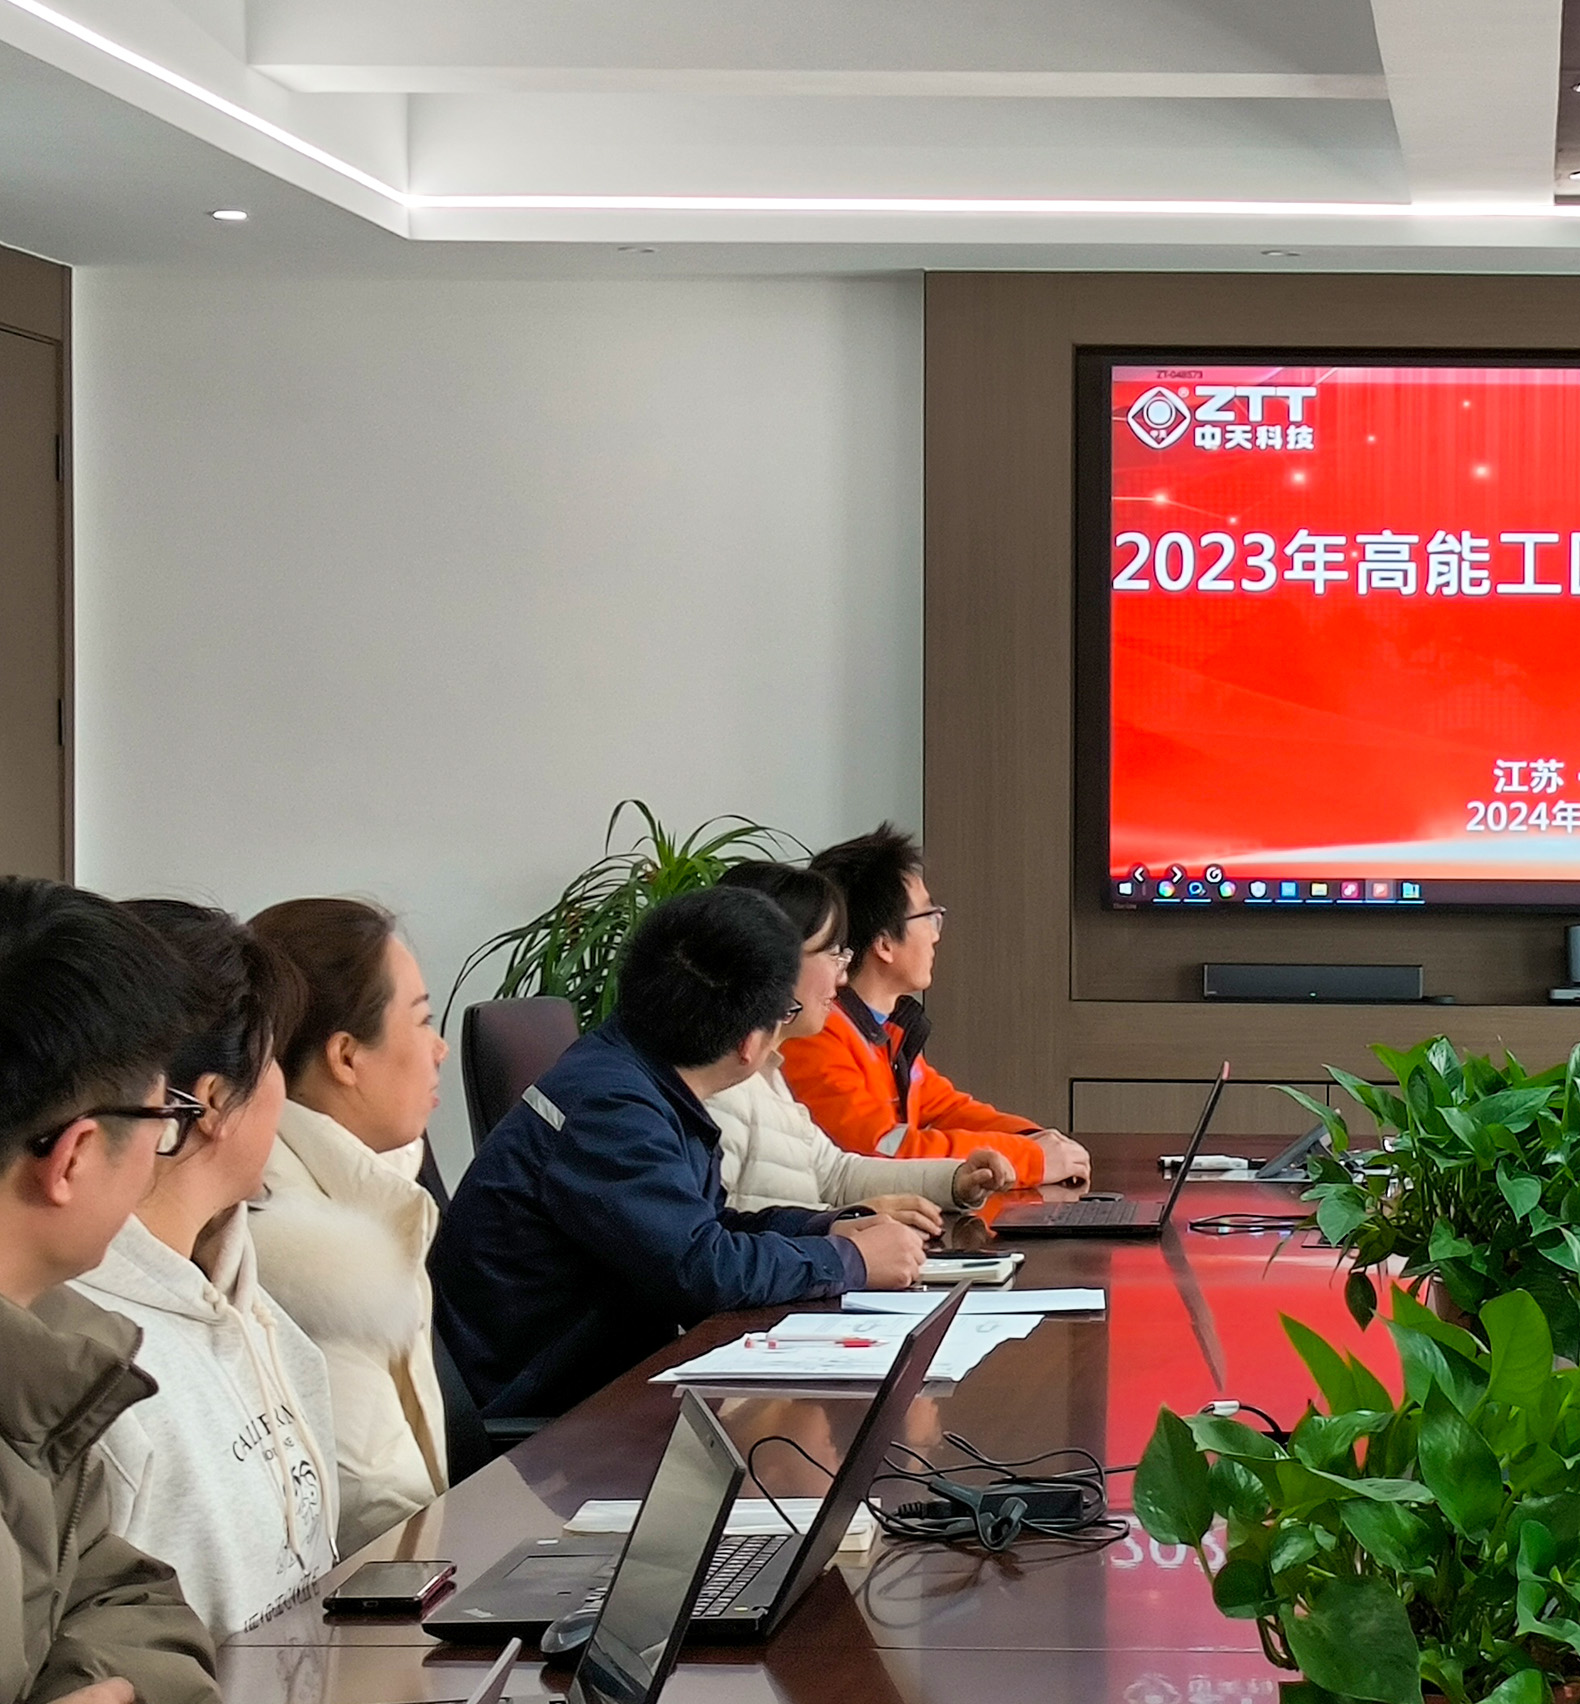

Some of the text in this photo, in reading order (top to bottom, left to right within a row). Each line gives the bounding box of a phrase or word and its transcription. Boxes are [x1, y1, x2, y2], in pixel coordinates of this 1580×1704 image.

[1194, 385, 1318, 422] ZTT
[1194, 423, 1315, 451] 中天科技
